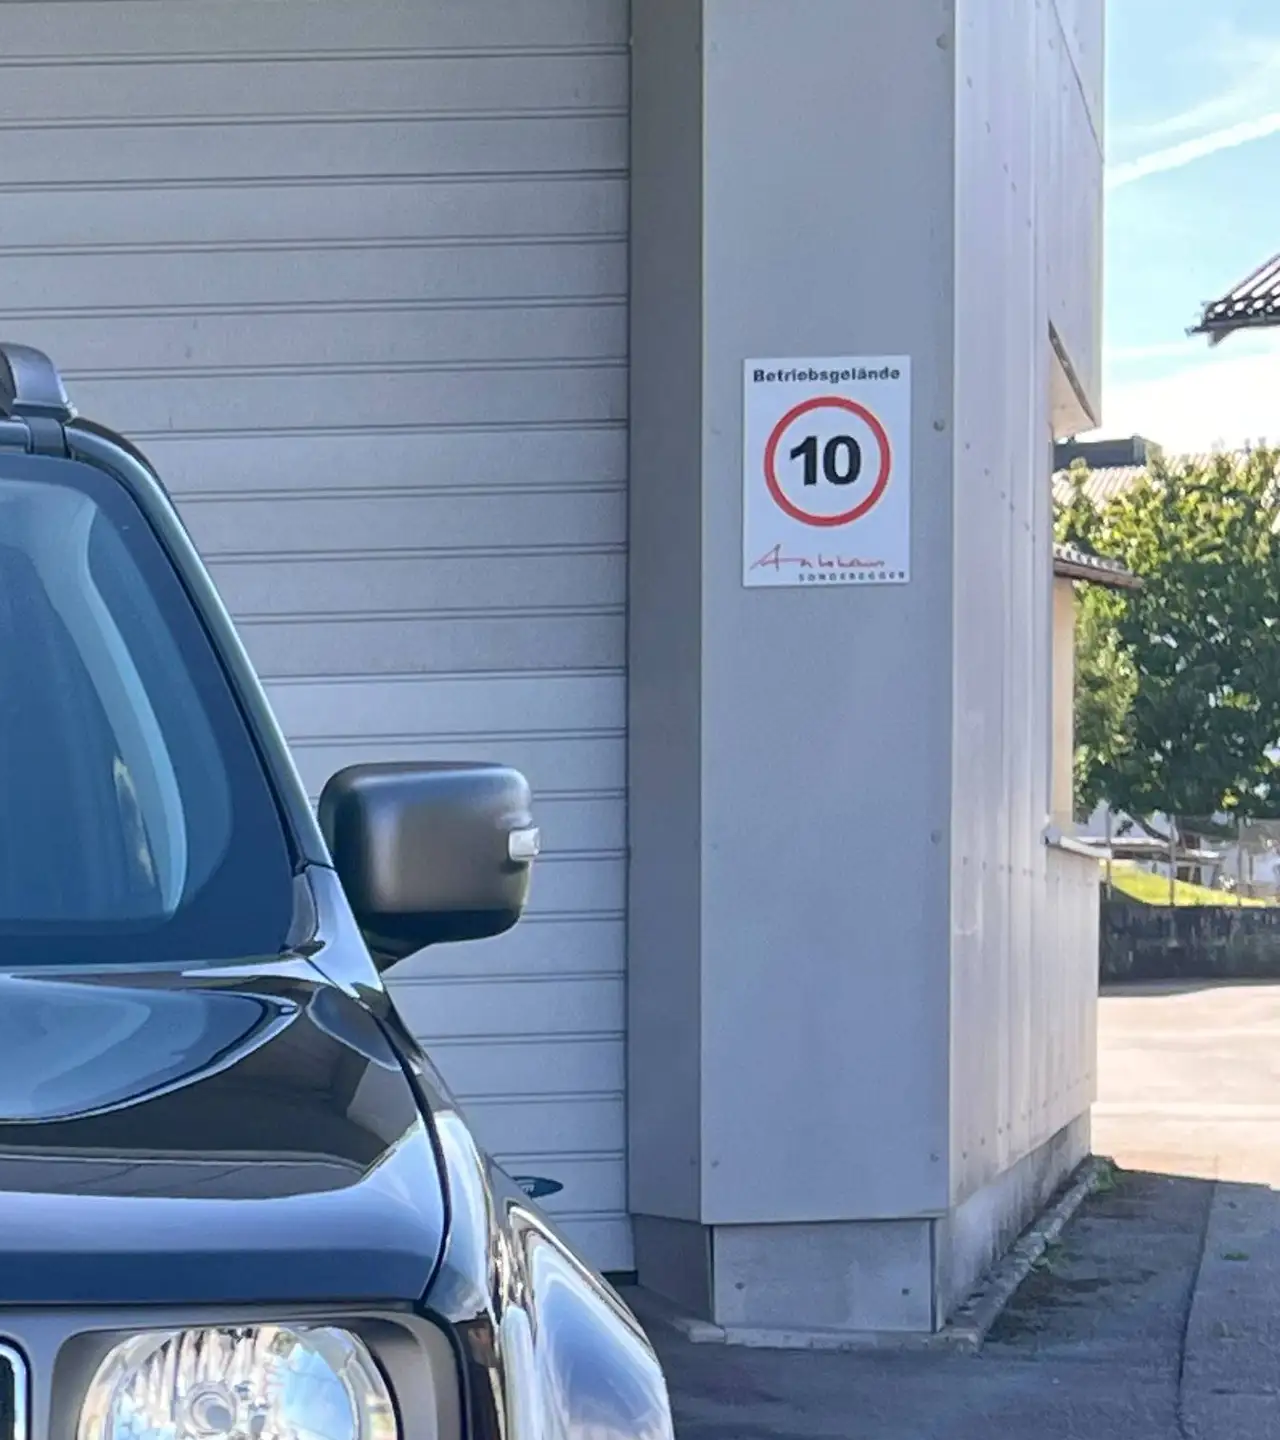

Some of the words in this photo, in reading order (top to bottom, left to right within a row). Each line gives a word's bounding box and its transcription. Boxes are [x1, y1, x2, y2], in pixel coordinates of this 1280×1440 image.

[753, 367, 901, 384] Betriebsgelände
[789, 435, 862, 487] 10
[798, 571, 905, 582] SONDEREGGER
